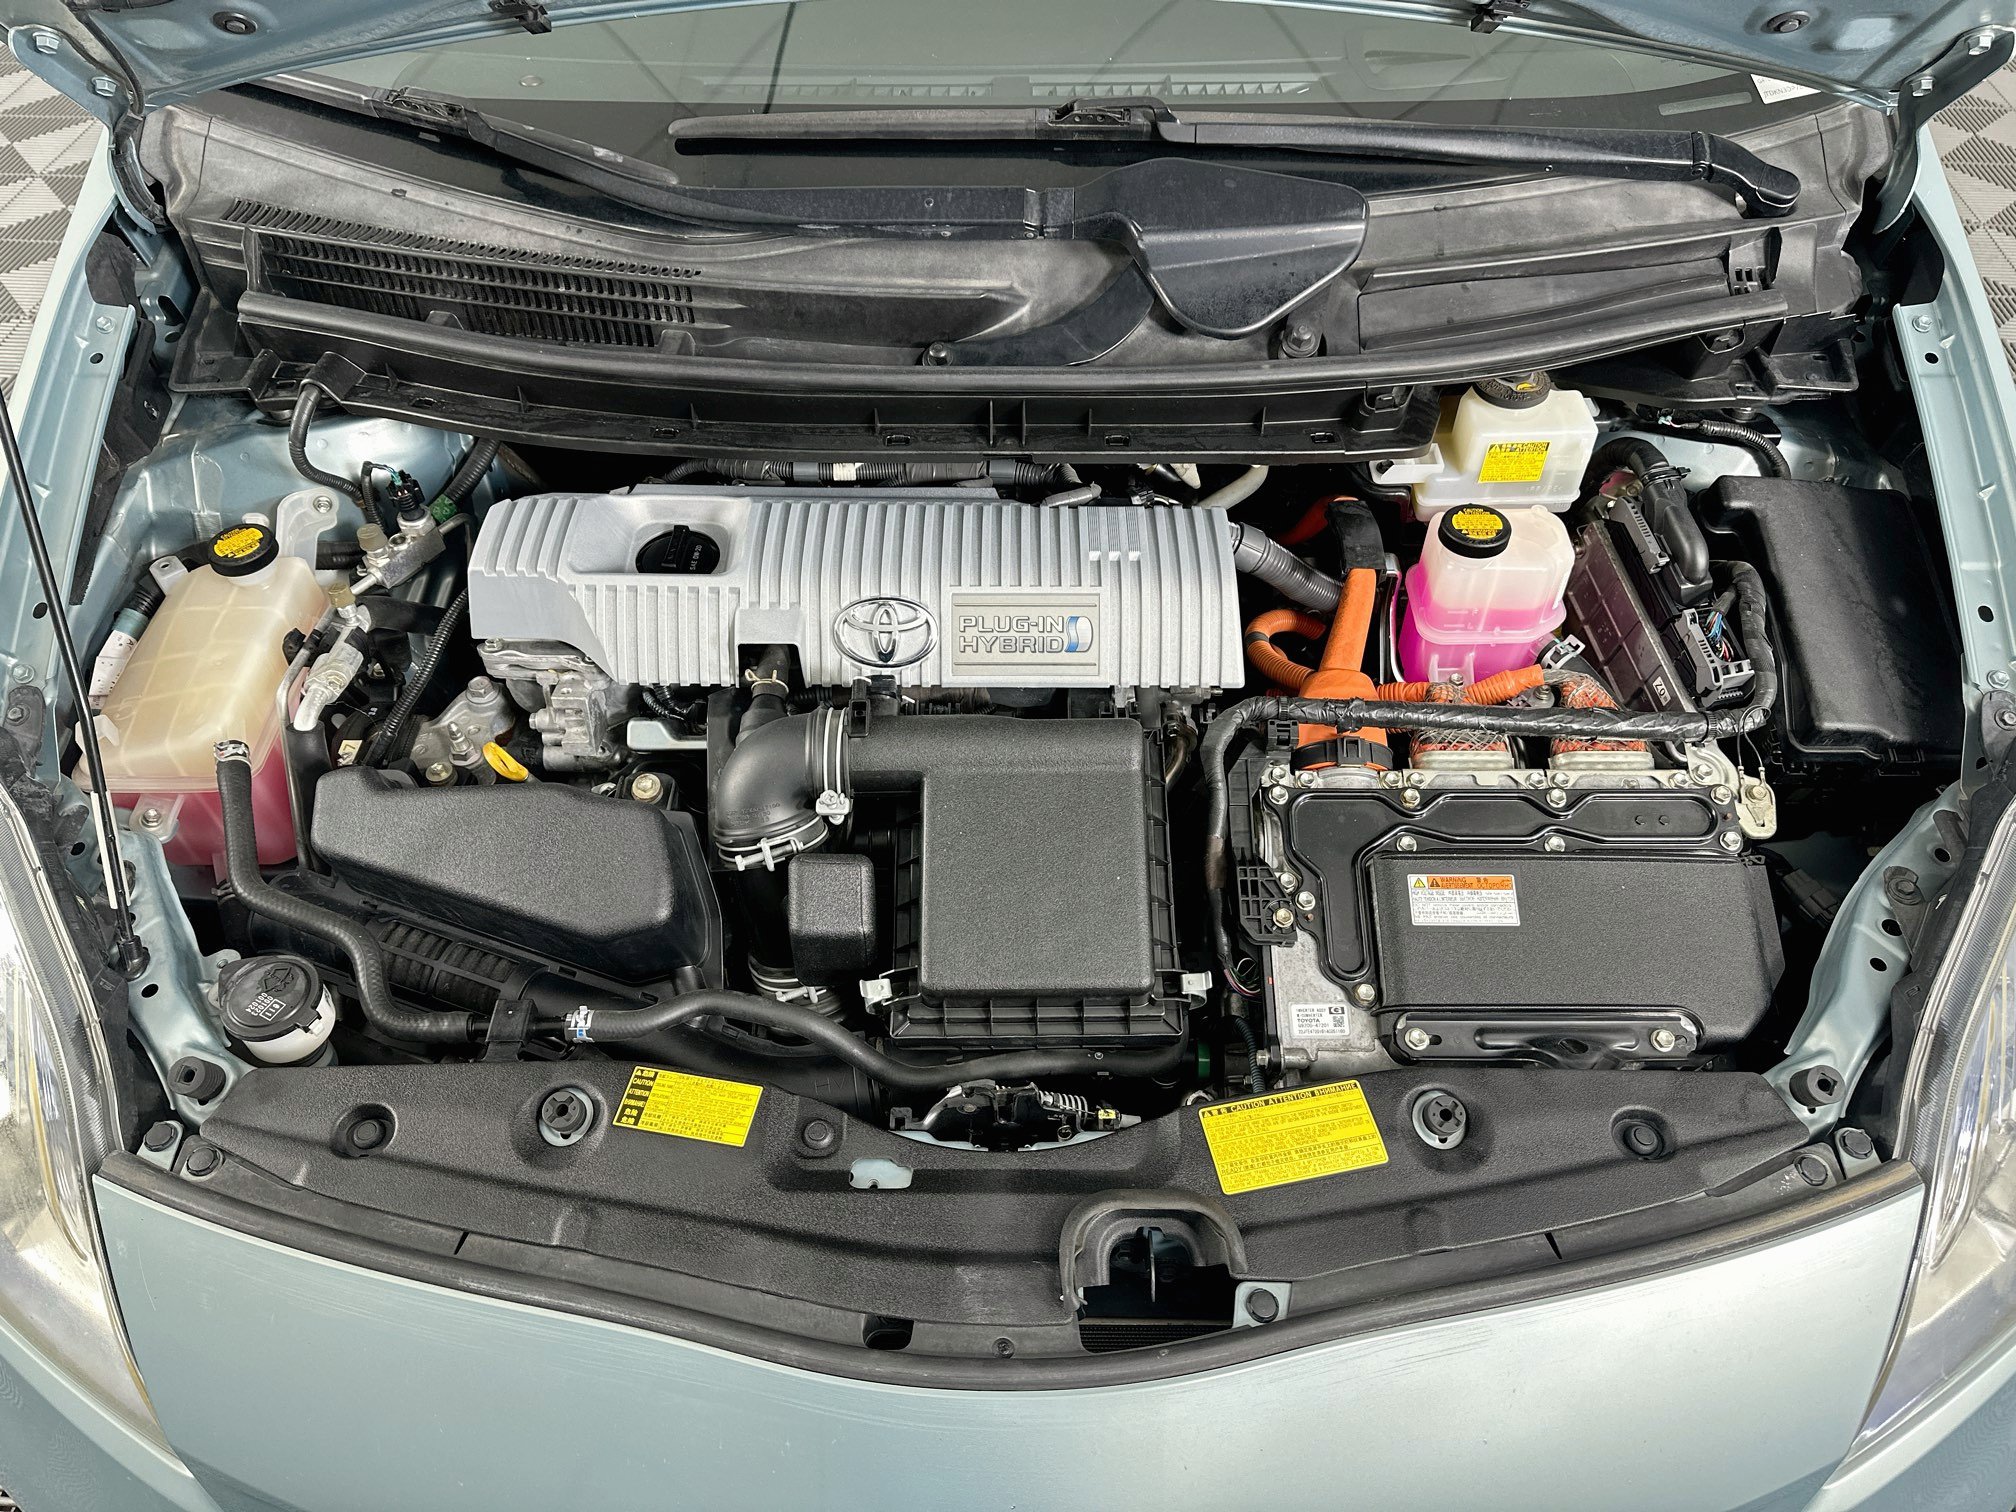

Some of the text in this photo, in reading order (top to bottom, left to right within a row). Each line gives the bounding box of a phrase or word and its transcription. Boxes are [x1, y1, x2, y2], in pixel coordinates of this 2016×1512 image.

[959, 615, 1064, 633] PLUG-IN
[959, 635, 1064, 653] HYBRID
[632, 1077, 655, 1087] CAUTION
[1231, 1101, 1265, 1112] CAUTION
[1269, 1091, 1311, 1105] ATTENTION
[1315, 1083, 1357, 1096] ВНИМАНИЕ
